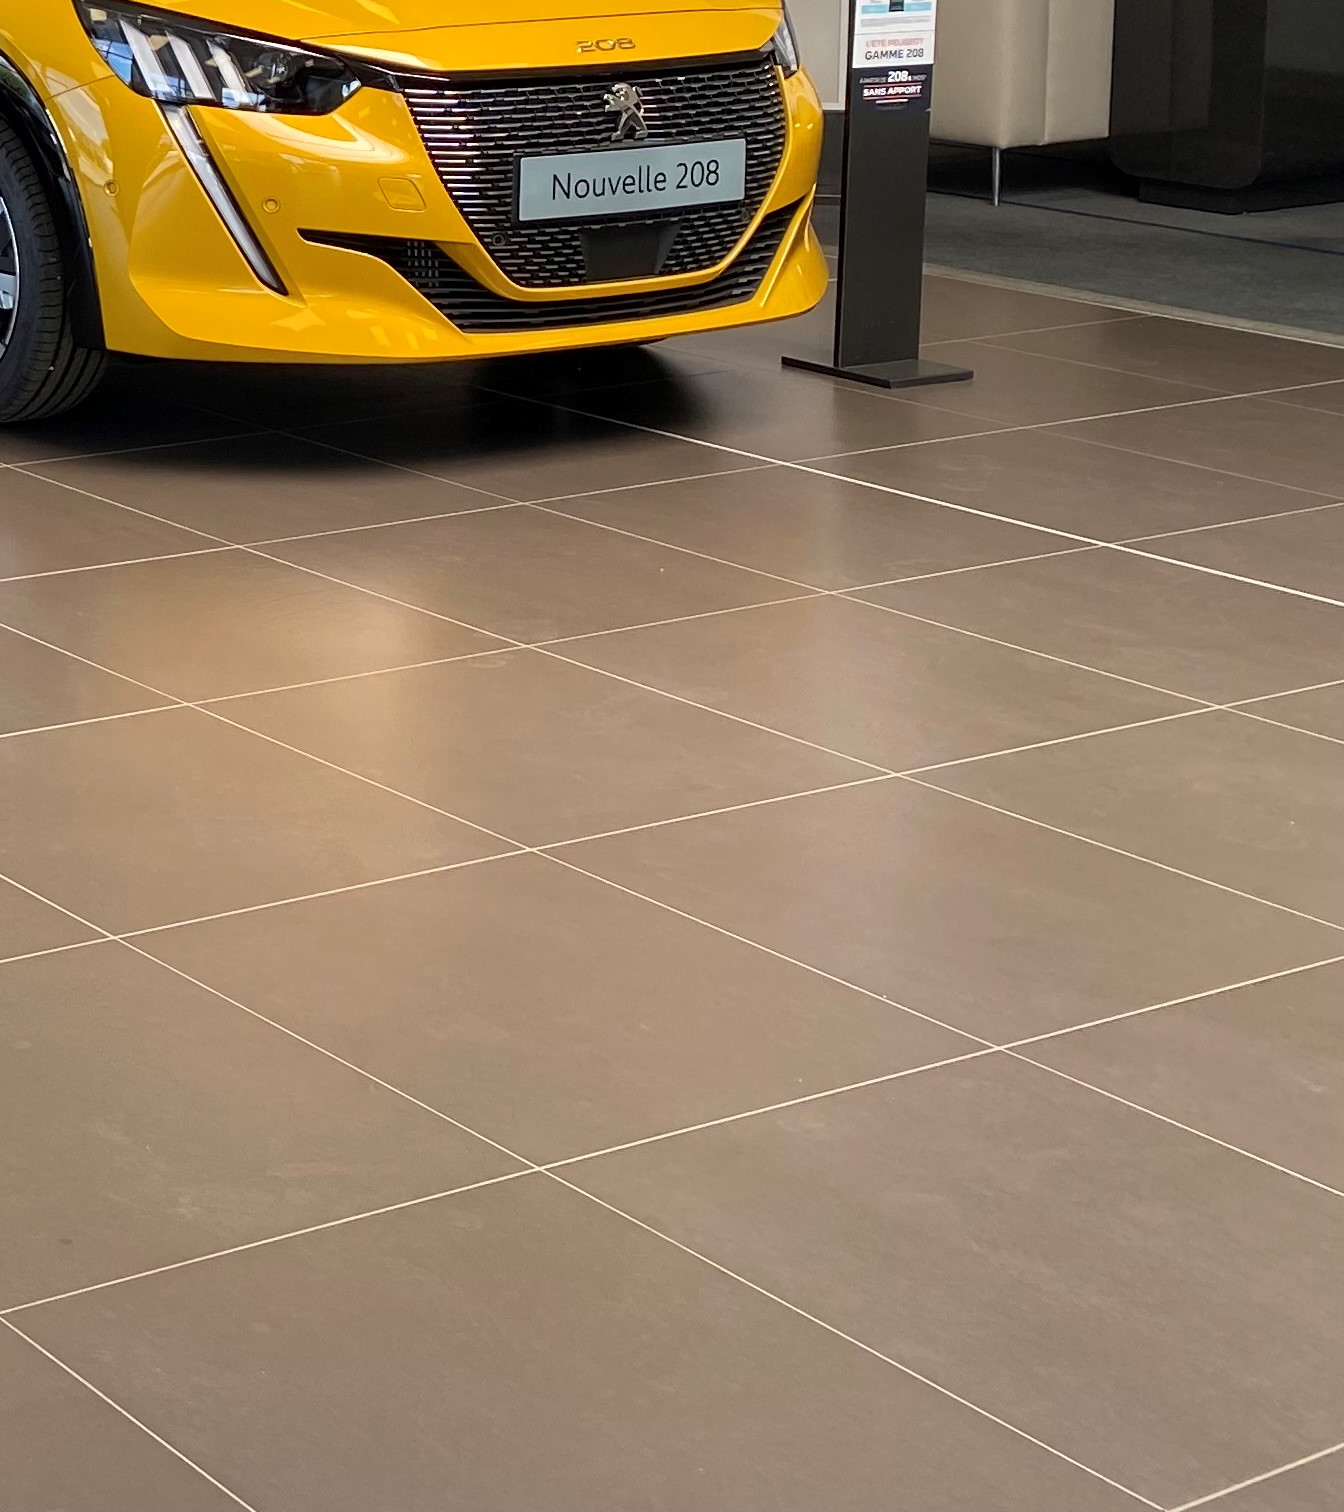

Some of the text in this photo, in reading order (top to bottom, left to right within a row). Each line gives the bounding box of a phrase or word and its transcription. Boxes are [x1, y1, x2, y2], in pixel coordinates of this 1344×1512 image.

[575, 37, 637, 54] 208
[865, 47, 925, 61] GAMME 208
[887, 70, 910, 83] 208
[863, 85, 923, 97] SANS APPORT
[551, 159, 721, 201] Nouvelle 208
